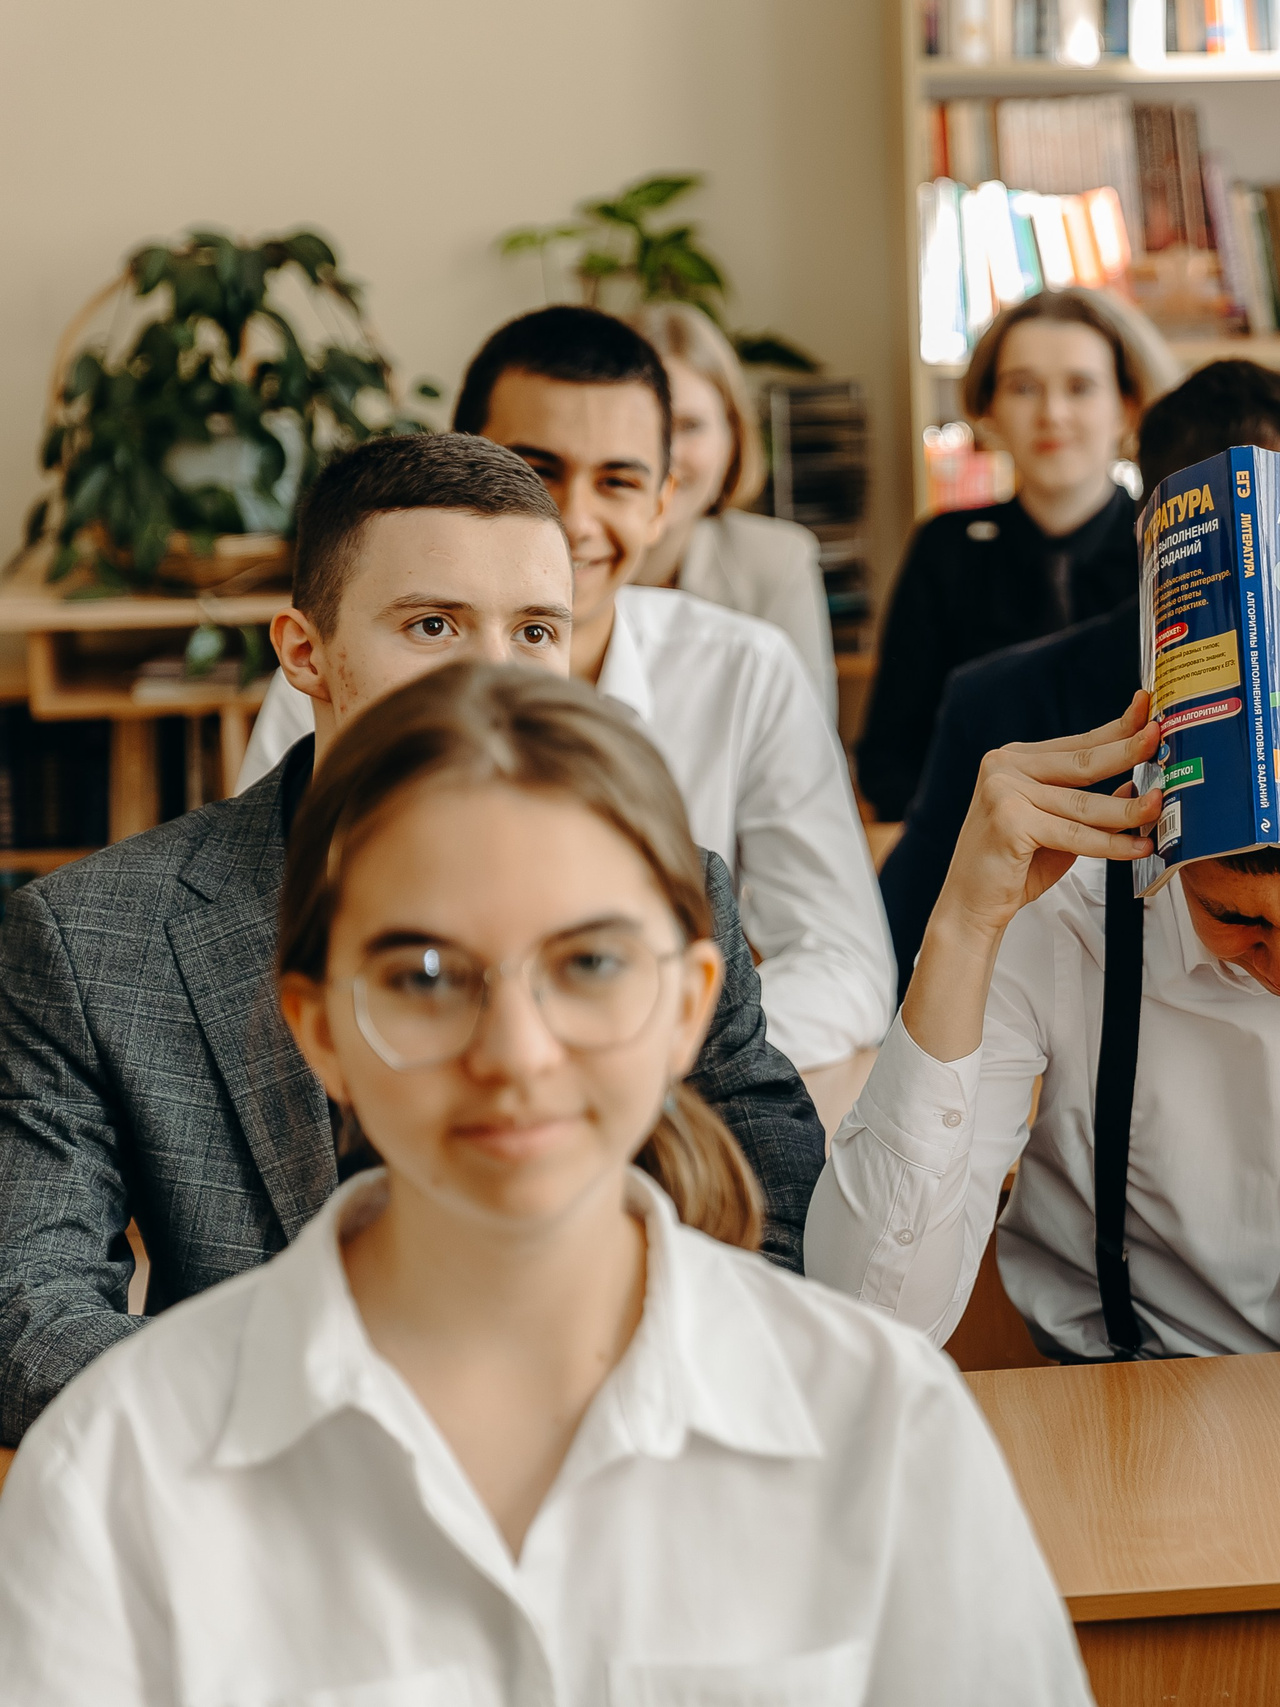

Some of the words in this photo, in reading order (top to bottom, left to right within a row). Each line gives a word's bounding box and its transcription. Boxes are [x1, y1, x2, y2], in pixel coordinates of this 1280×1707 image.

[1236, 470, 1251, 499] ЕГЭ
[1160, 539, 1202, 569] ЗАДАНИЙ
[1240, 513, 1256, 579] ЛИТЕРАТУРА
[1180, 583, 1190, 592] по
[1246, 591, 1258, 648] АЛГОРИТМЫ
[1249, 650, 1263, 715] ВЫПОЛНЕНИЯ
[1182, 703, 1229, 722] АЛГОРИТМАМ
[1254, 716, 1266, 761] ТИПОВЫХ
[1169, 765, 1194, 779] ЛЕГКО!
[1257, 763, 1270, 808] ЗАДАНИЙ
